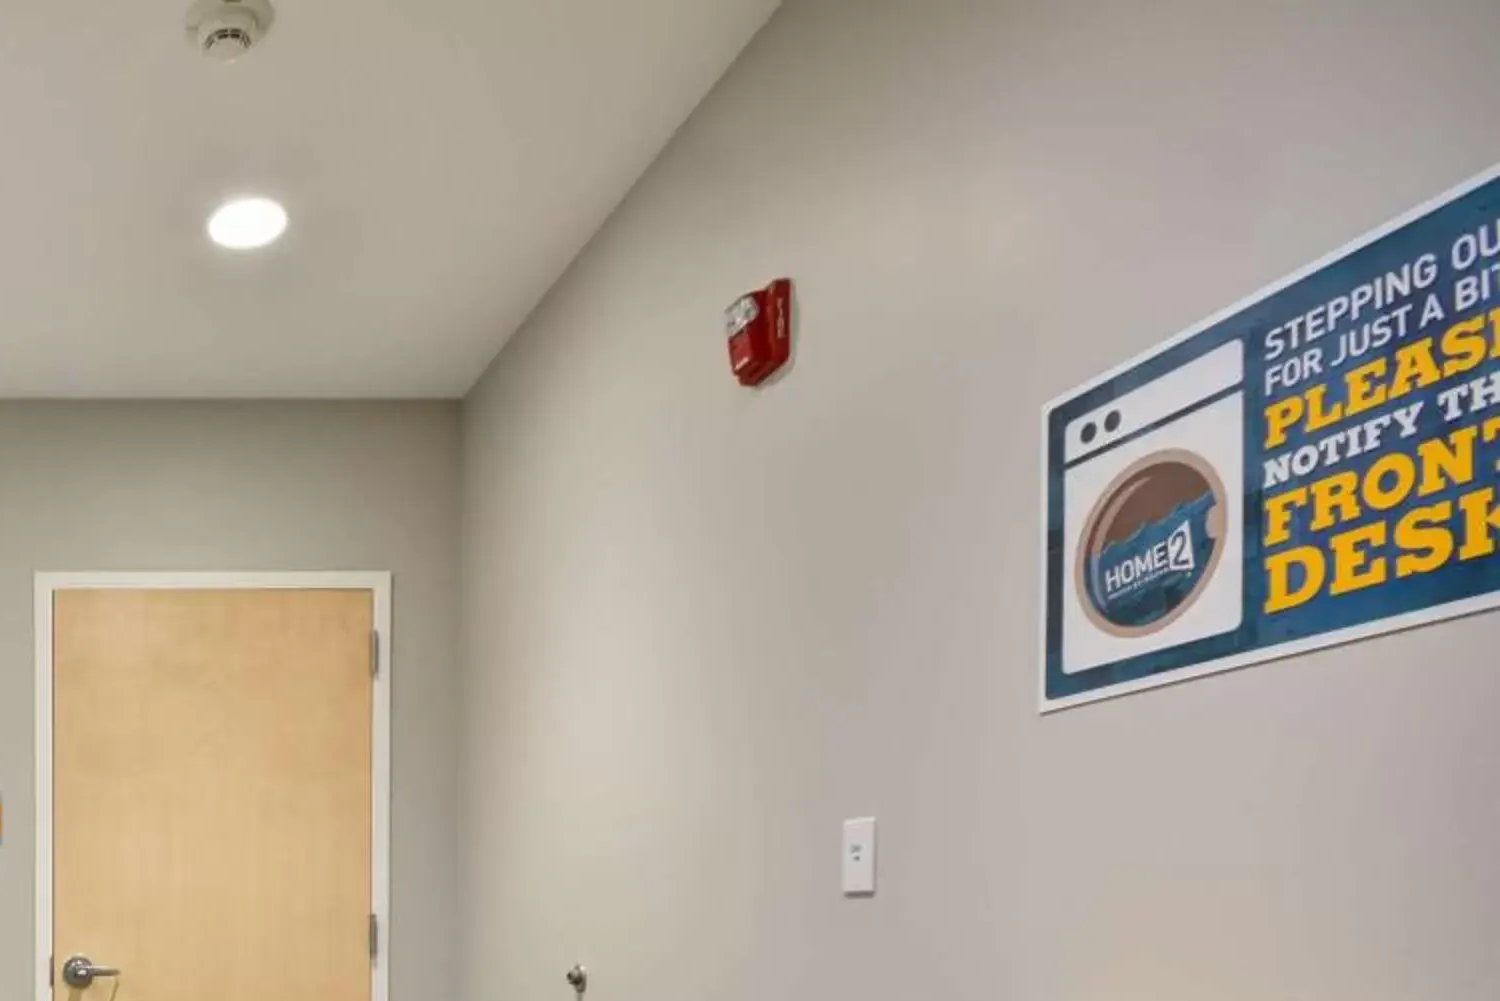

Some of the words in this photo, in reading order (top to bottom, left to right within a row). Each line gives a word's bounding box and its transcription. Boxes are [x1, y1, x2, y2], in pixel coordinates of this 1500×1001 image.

[1264, 252, 1438, 361] STEPPING
[1265, 347, 1323, 396] FOR
[1330, 303, 1413, 367] JUST
[1419, 293, 1445, 329] A
[1264, 306, 1500, 449] PLEAS
[1263, 401, 1424, 488] NOTIFY
